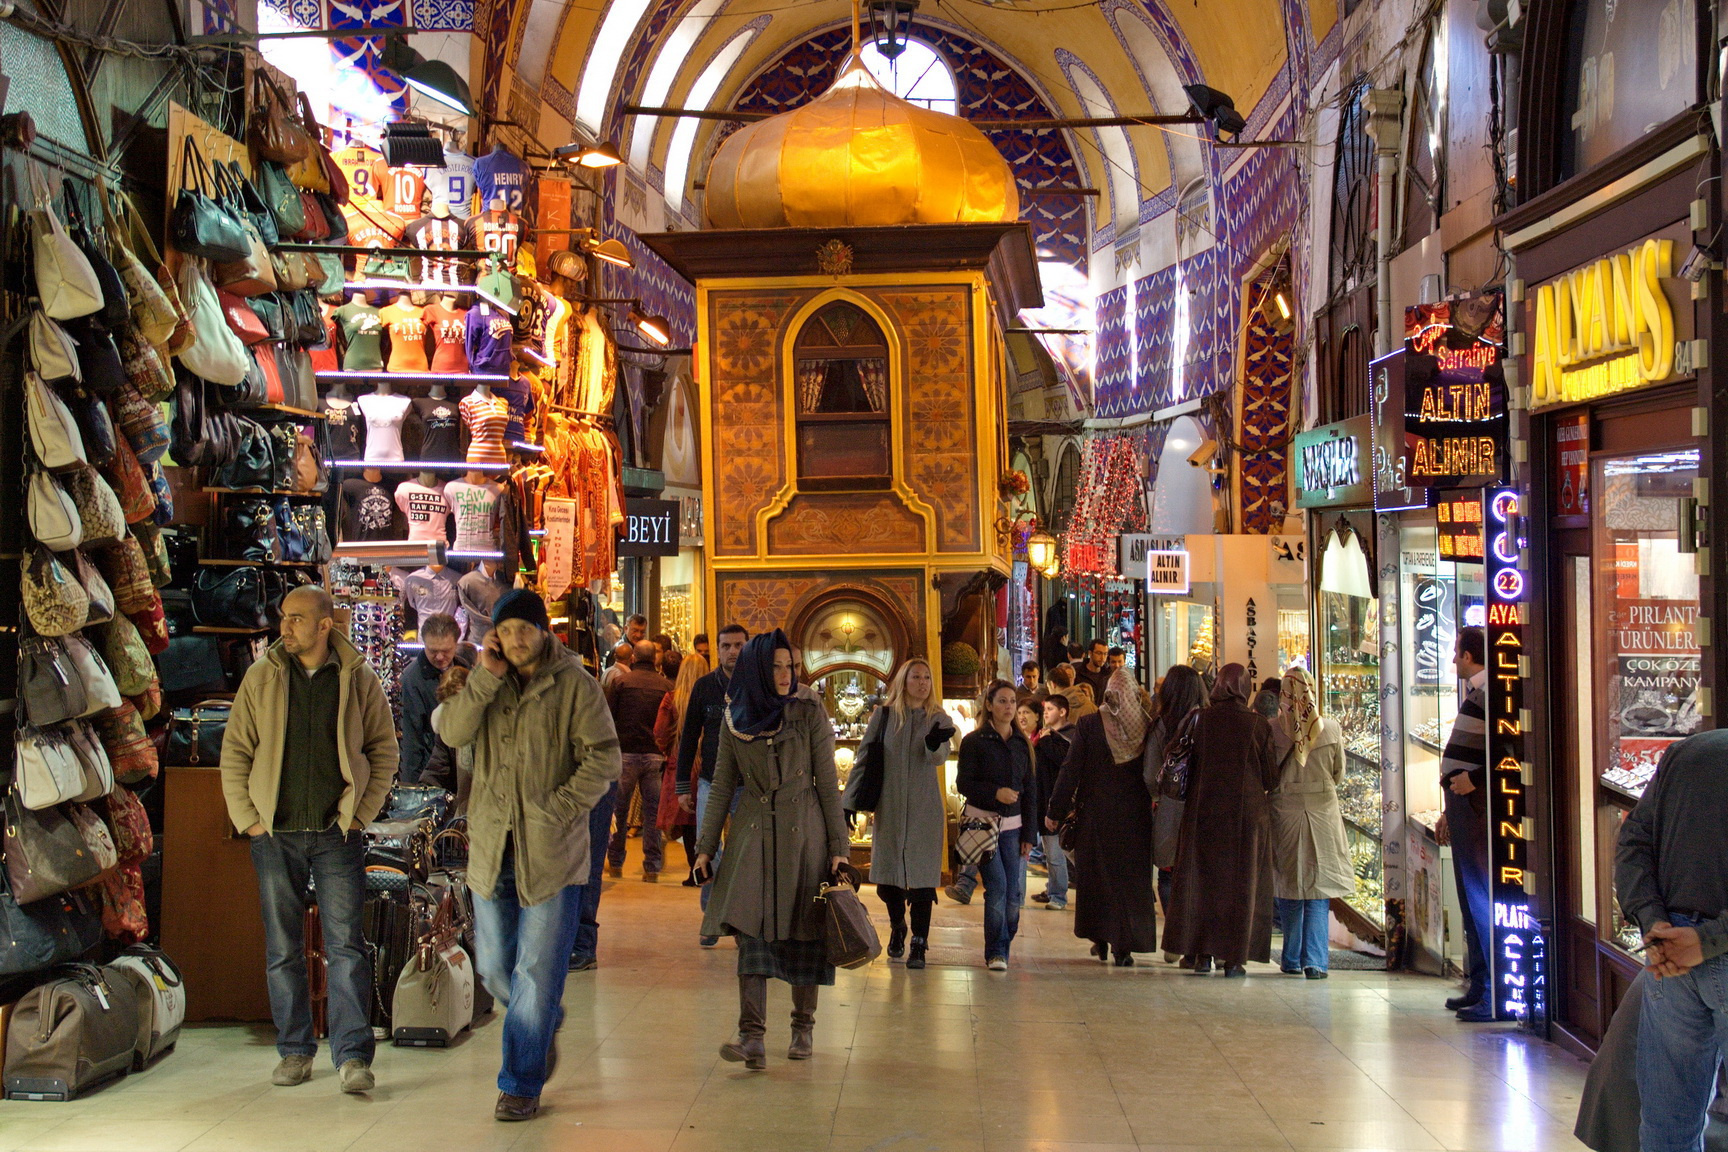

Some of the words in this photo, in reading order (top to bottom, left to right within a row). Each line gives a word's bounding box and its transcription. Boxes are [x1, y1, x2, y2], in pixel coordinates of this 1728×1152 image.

[354, 169, 369, 197] 9
[395, 173, 415, 204] 10
[449, 176, 465, 204] 9
[494, 172, 523, 186] HENRY
[484, 222, 518, 232] RONAINHO
[1532, 239, 1674, 407] ALYANS
[1438, 342, 1496, 373] Sarrafiye
[1675, 342, 1693, 375] 84
[1419, 382, 1491, 424] ALTIN
[1412, 436, 1495, 477] ALINIR
[410, 494, 440, 502] G-STAR
[411, 503, 427, 511] RAW
[455, 488, 486, 502] RAW
[620, 510, 671, 543] BEYİ
[1156, 555, 1180, 568] ALTIN
[1151, 571, 1178, 583] ALINIR
[1499, 575, 1518, 590] 22
[1489, 604, 1519, 625] AYA
[1620, 626, 1700, 650] ÜRÜNLER
[1626, 659, 1661, 674] ÇOK
[1495, 632, 1521, 735] ALTIN
[1496, 757, 1523, 885] ALINIR
